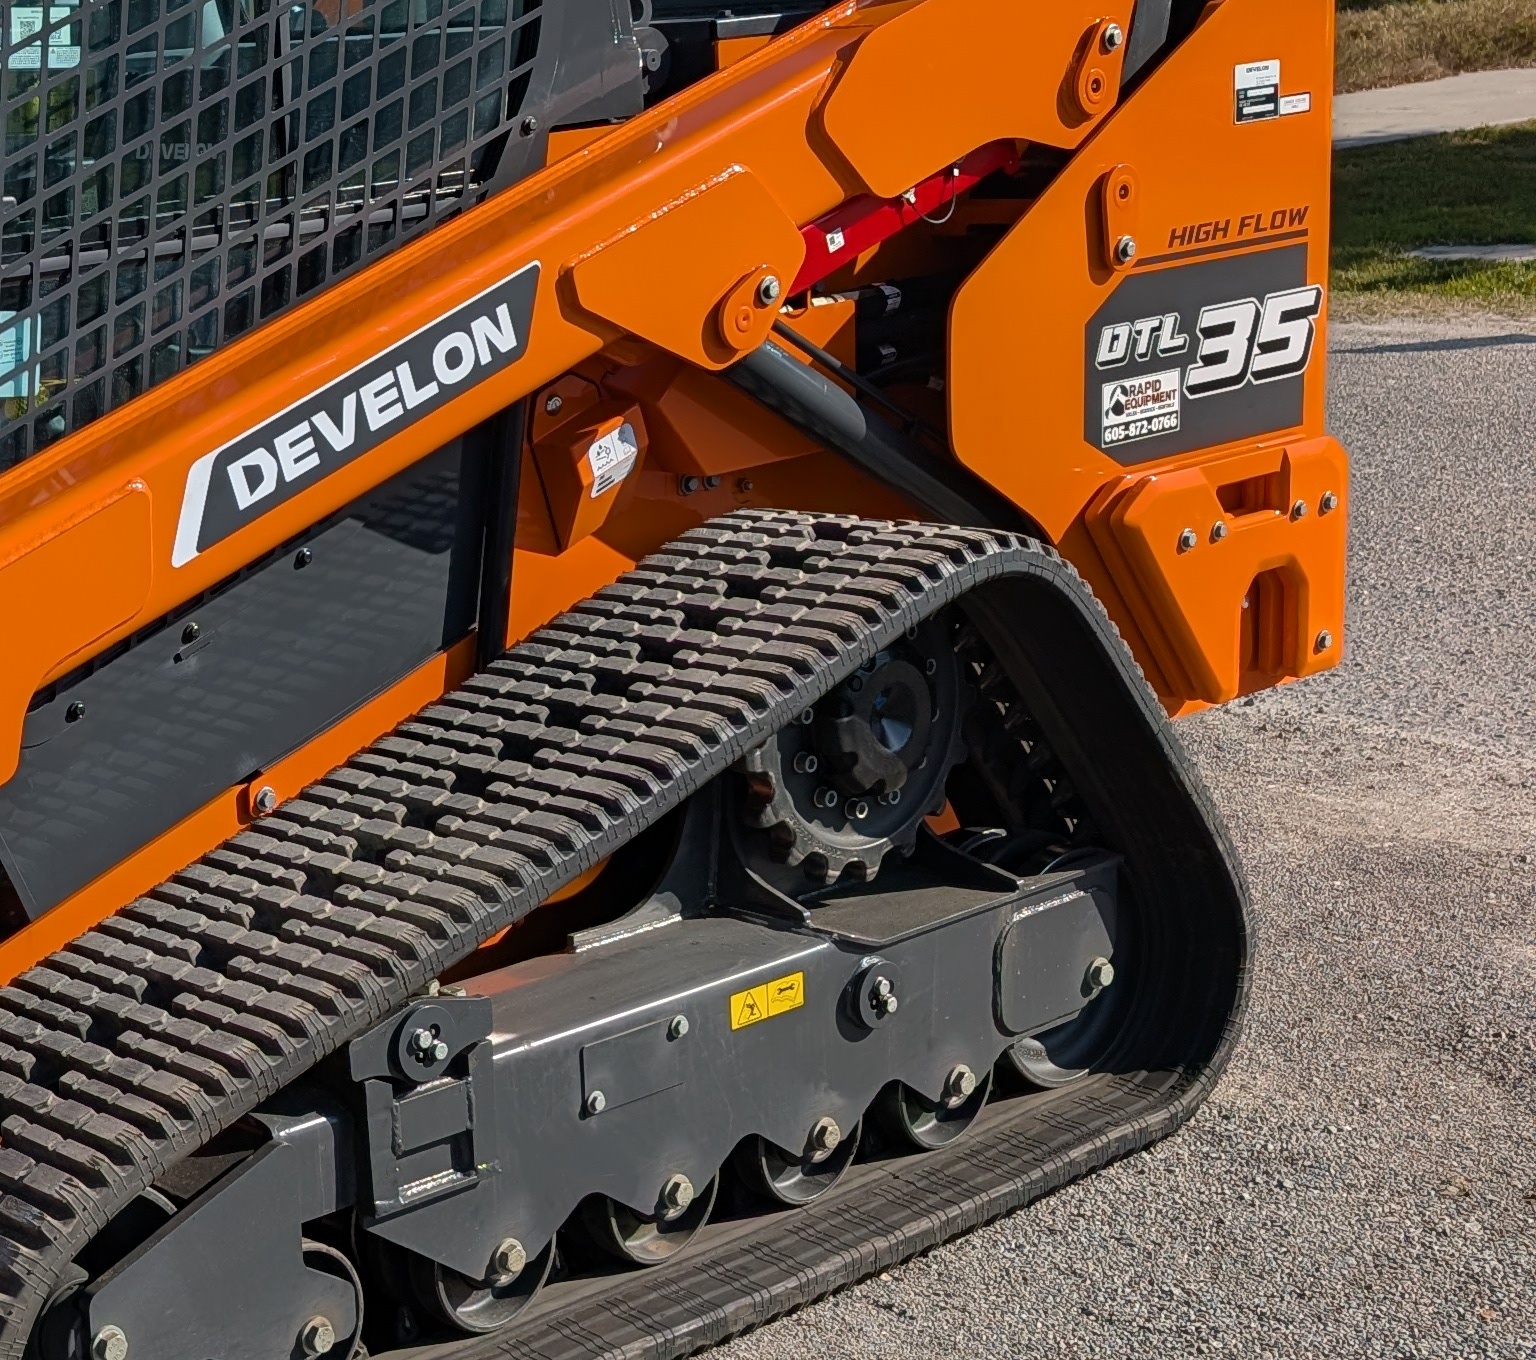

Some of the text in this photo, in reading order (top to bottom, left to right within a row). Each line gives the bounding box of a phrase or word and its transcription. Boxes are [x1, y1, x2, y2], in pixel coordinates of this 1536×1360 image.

[1167, 205, 1310, 249] HIGH FLOW
[1095, 284, 1324, 400] DTL 35
[226, 301, 518, 512] DEVELON
[1124, 389, 1177, 410] EQUIPMENT
[1128, 379, 1162, 397] RAPID
[1104, 413, 1178, 443] 605-872-0766
